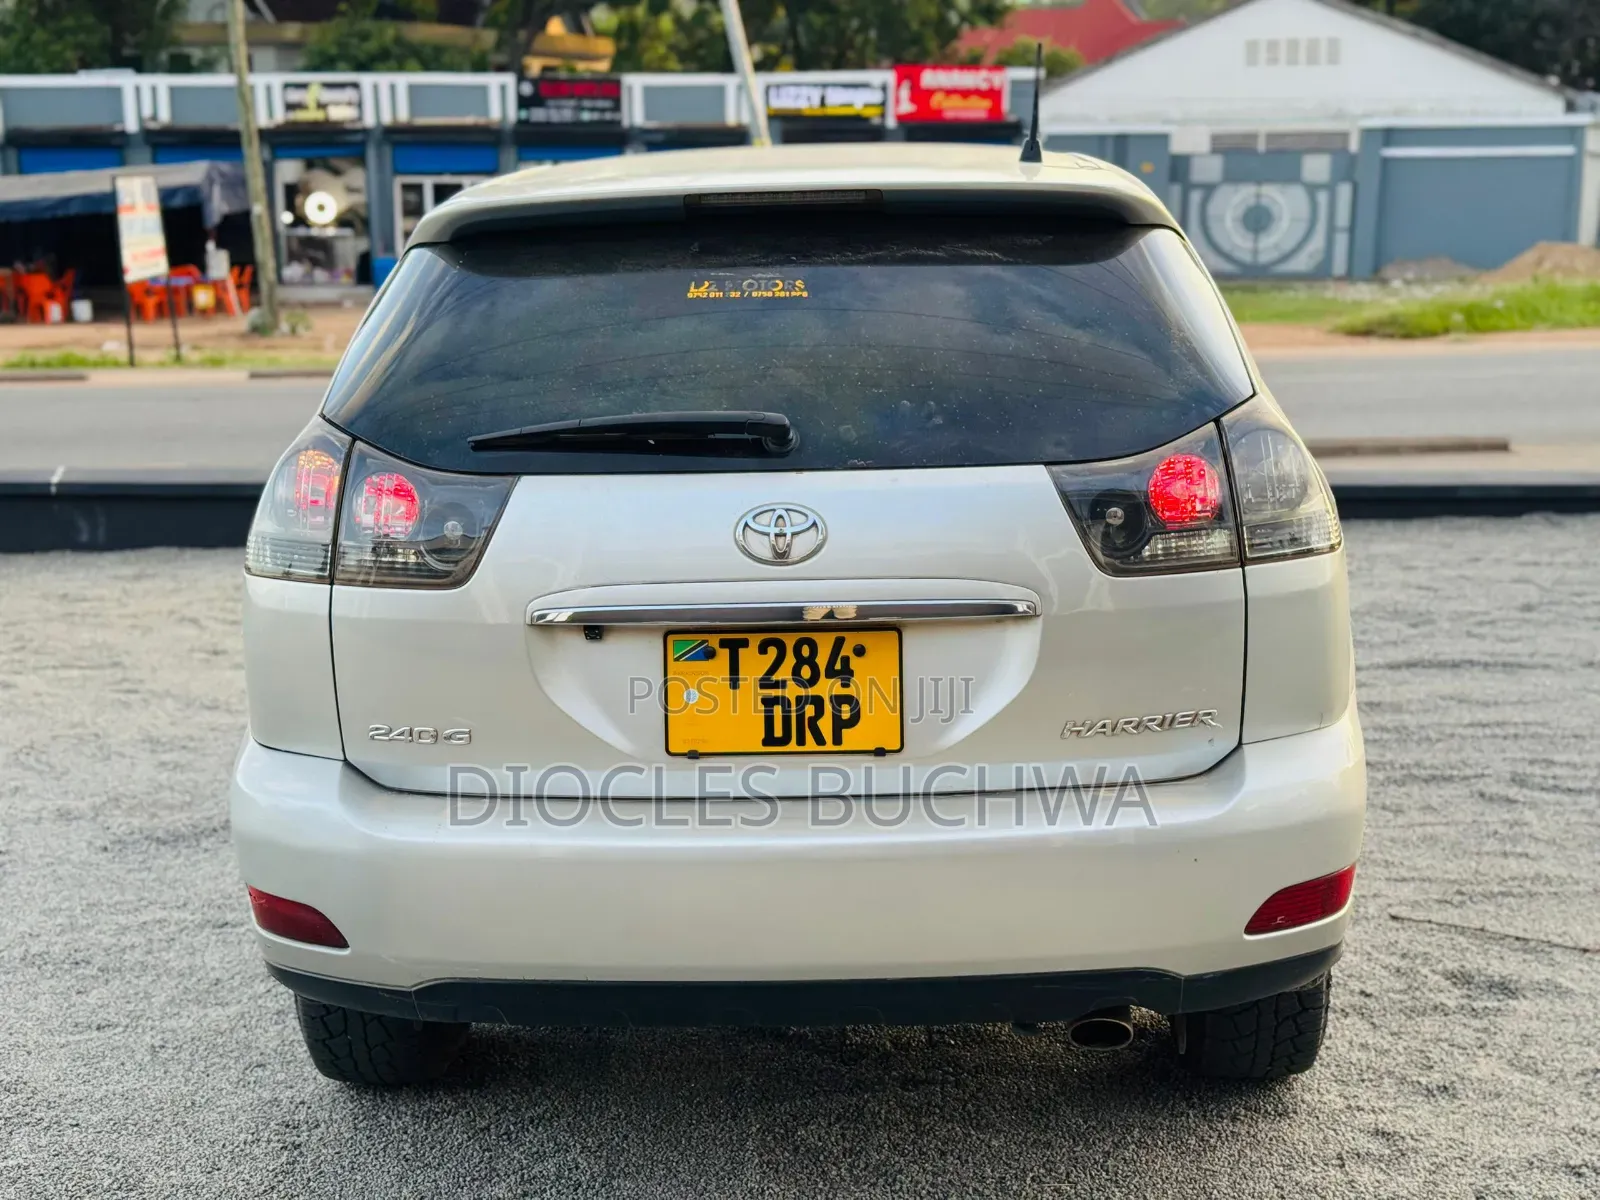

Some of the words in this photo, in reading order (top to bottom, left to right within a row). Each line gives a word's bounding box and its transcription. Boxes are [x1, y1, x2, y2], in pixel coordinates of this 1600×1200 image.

[725, 279, 805, 292] OTORS
[718, 637, 749, 690] T
[758, 636, 855, 690] 284
[368, 724, 439, 744] 240
[442, 728, 472, 745] G
[761, 694, 861, 747] DRP
[1060, 709, 1223, 740] HARRIER
